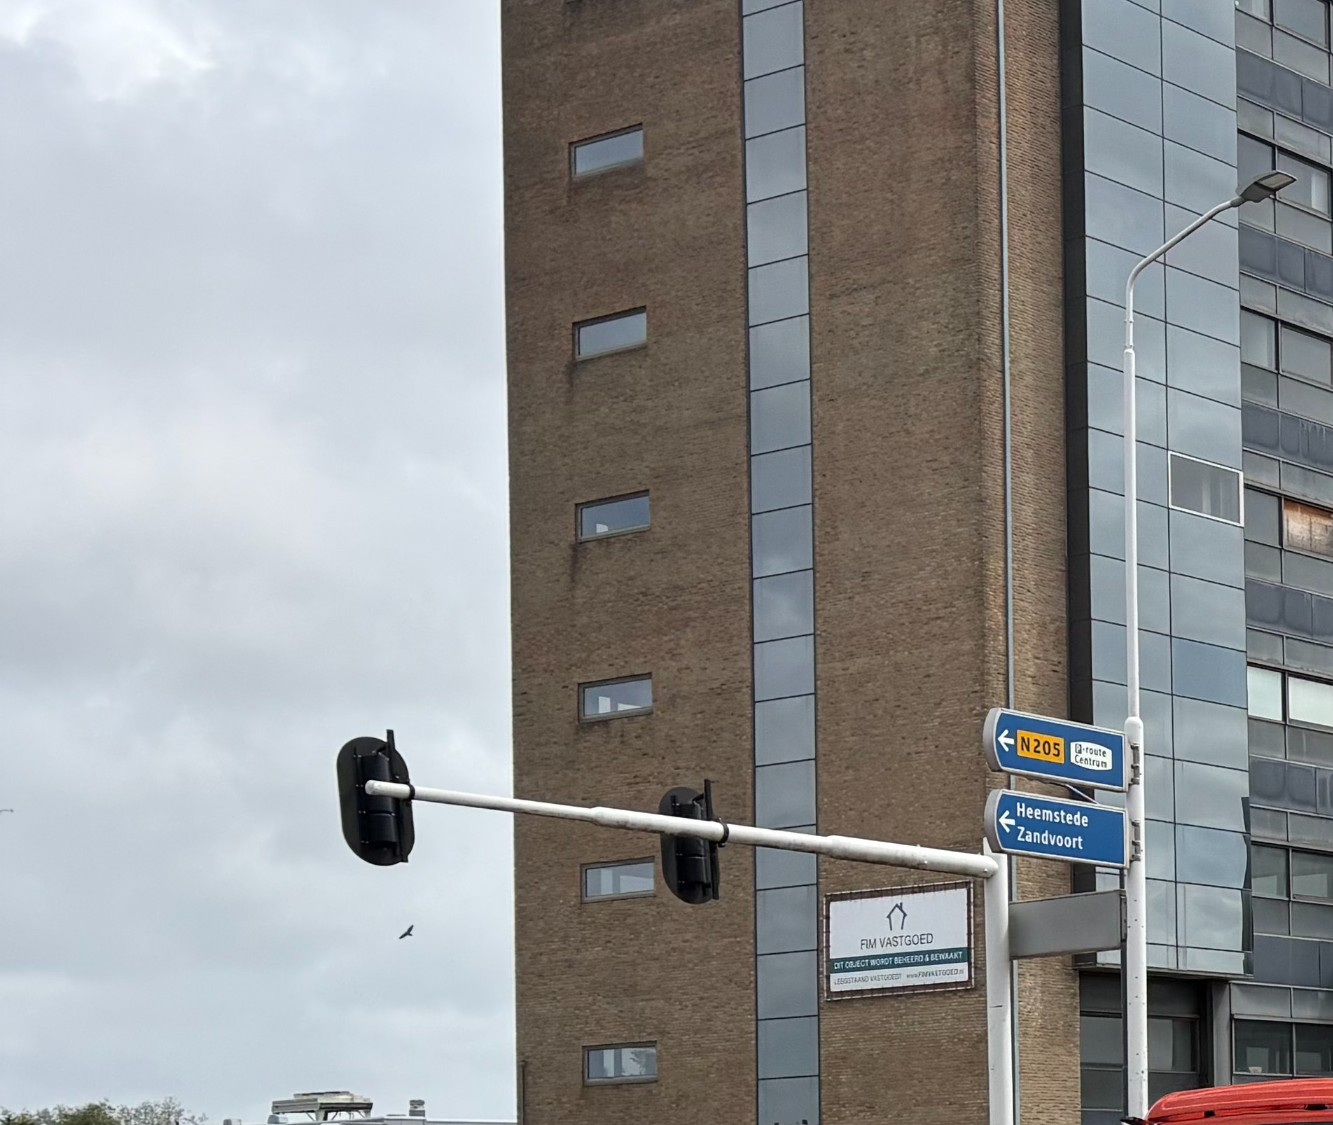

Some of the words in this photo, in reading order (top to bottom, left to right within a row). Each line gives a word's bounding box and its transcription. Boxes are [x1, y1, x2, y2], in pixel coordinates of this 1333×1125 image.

[1020, 736, 1061, 757] N205
[1074, 754, 1109, 770] Centrum
[1016, 802, 1089, 828] Heemstede
[1016, 826, 1084, 850] Zandvoort
[860, 938, 877, 950] FIM
[879, 933, 934, 948] VASTGOED
[834, 961, 844, 970] DIT
[845, 959, 869, 969] OBJECT
[870, 957, 893, 966] WORDT
[894, 954, 924, 965] BEHEERD
[930, 951, 963, 961] BEWAAKT
